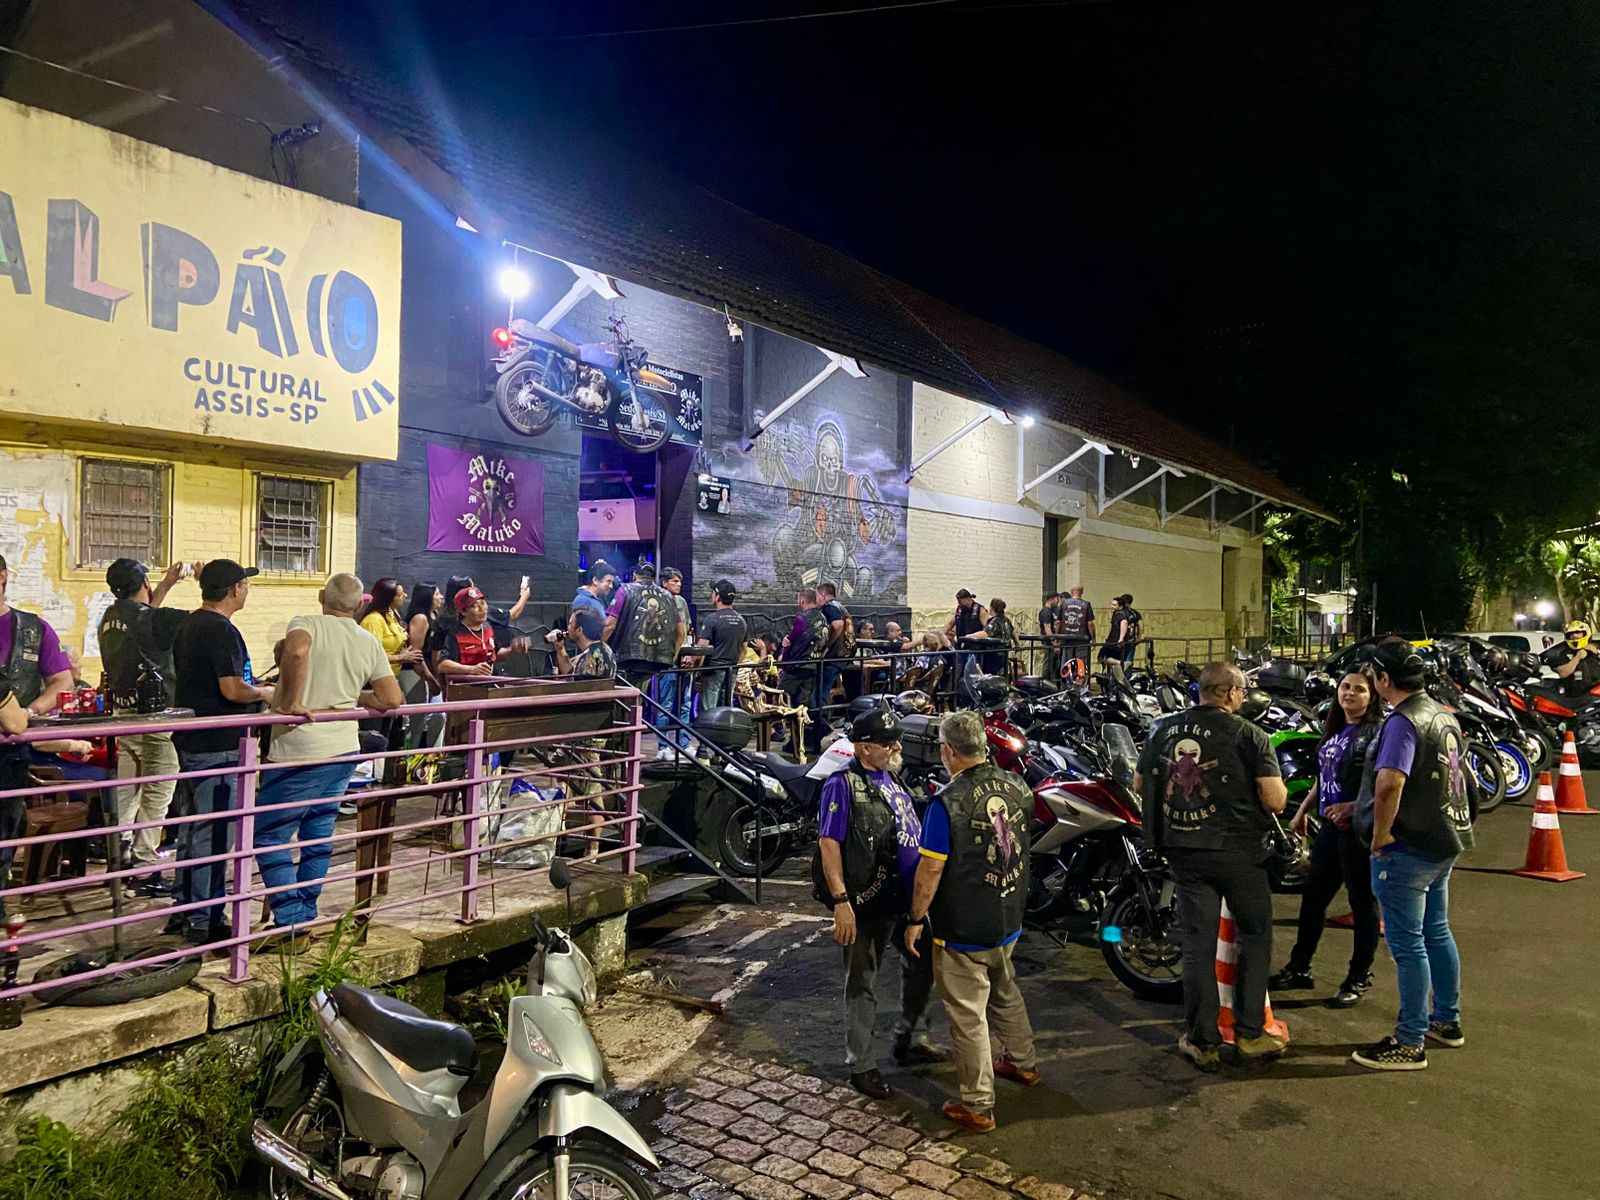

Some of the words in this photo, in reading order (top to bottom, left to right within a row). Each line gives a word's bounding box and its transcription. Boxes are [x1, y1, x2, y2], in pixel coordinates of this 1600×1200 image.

[183, 357, 327, 403] CULTURAL
[194, 388, 319, 424] ASSIS-SP
[468, 455, 515, 484] Mike
[457, 512, 522, 543] Maluko
[462, 543, 517, 554] comando
[1167, 724, 1212, 738] Mike
[973, 780, 1010, 803] Mike
